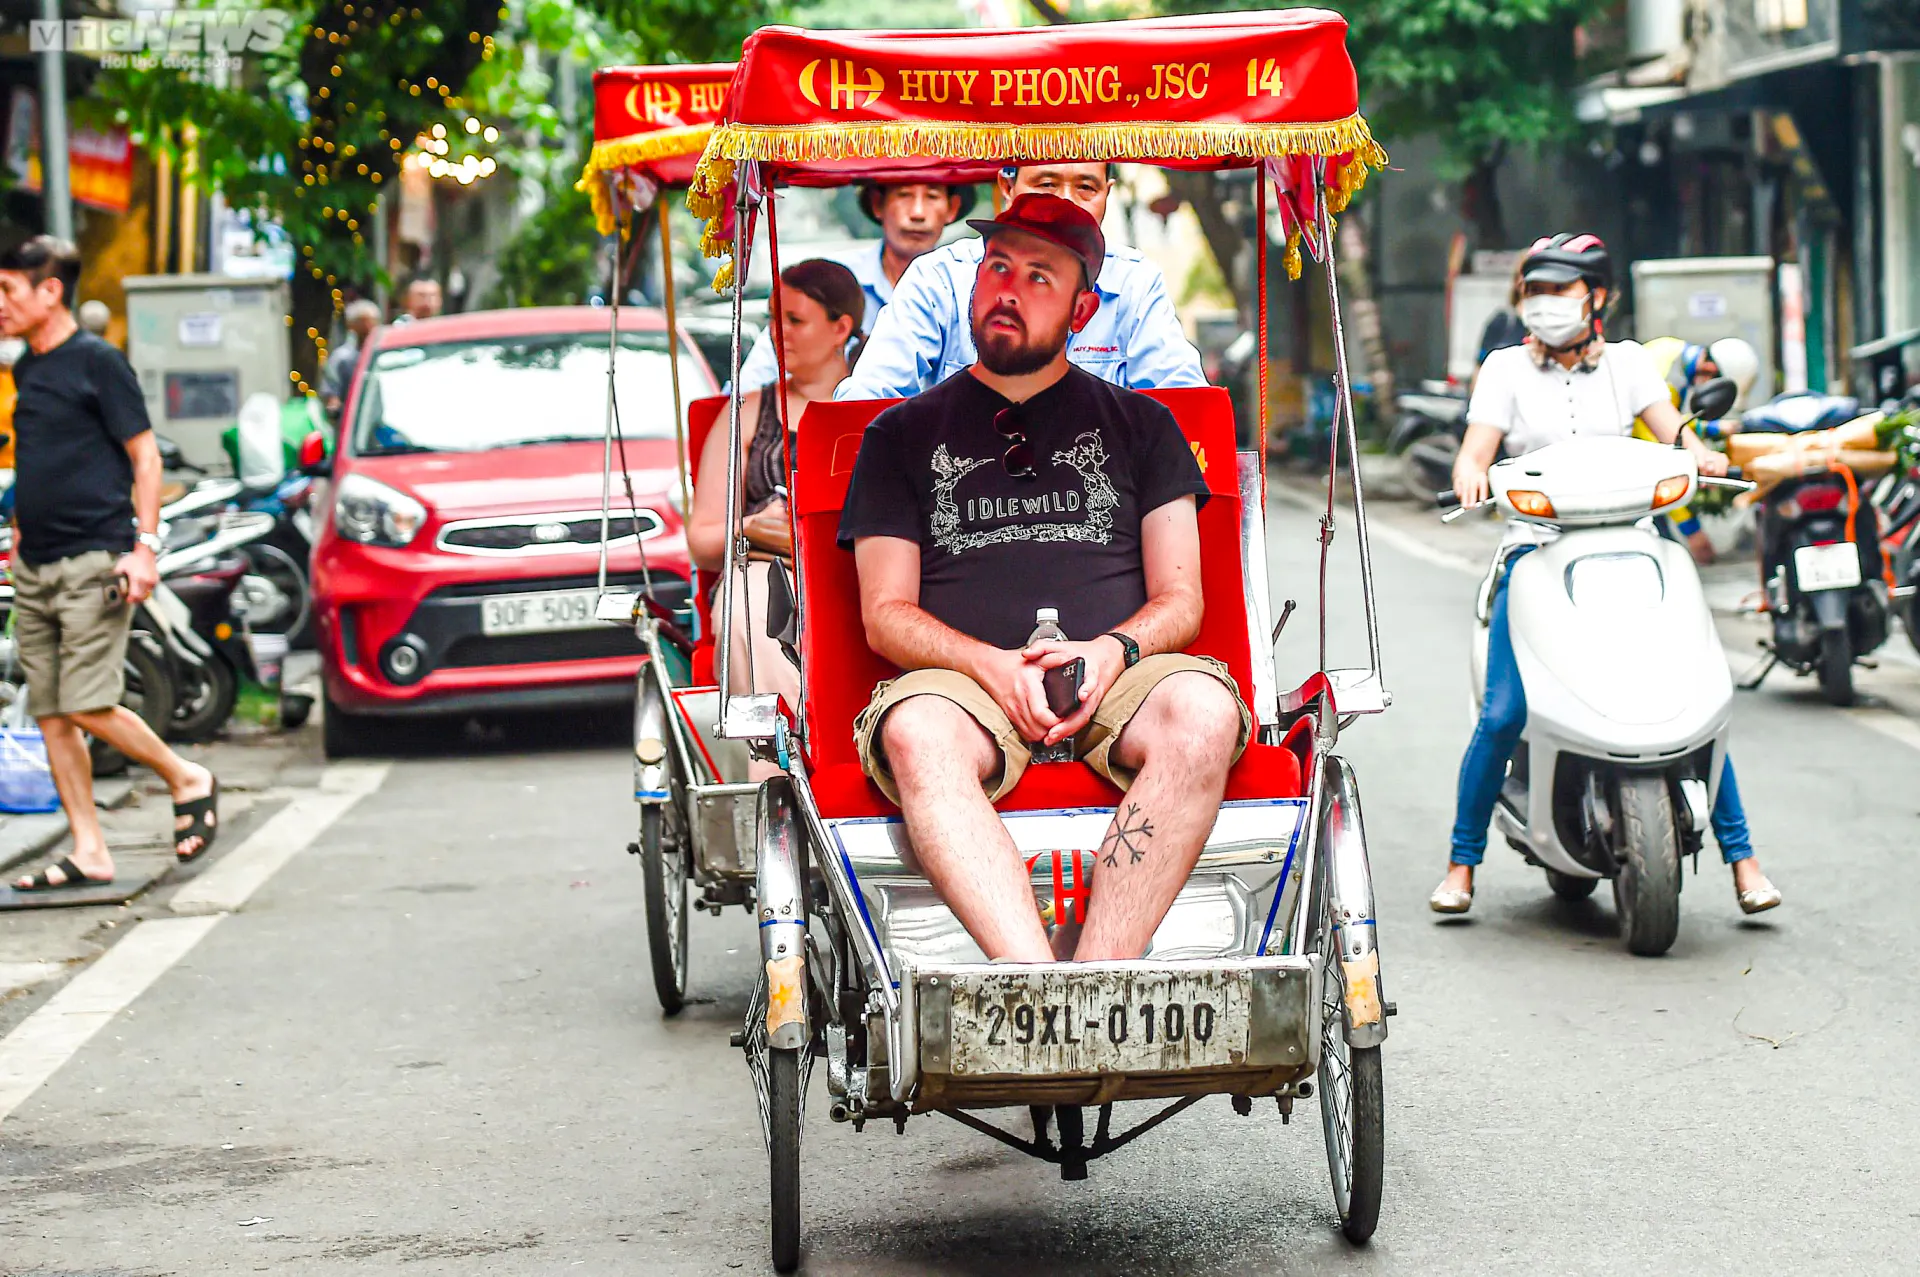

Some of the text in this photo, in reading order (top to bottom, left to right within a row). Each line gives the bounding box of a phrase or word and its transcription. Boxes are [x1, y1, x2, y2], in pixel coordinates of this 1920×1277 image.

[898, 69, 979, 105] HUY
[1145, 62, 1211, 100] JSC
[1246, 58, 1284, 97] 14
[967, 490, 1080, 521] IDLEWILD
[986, 1002, 1215, 1046] 29XL-0100
